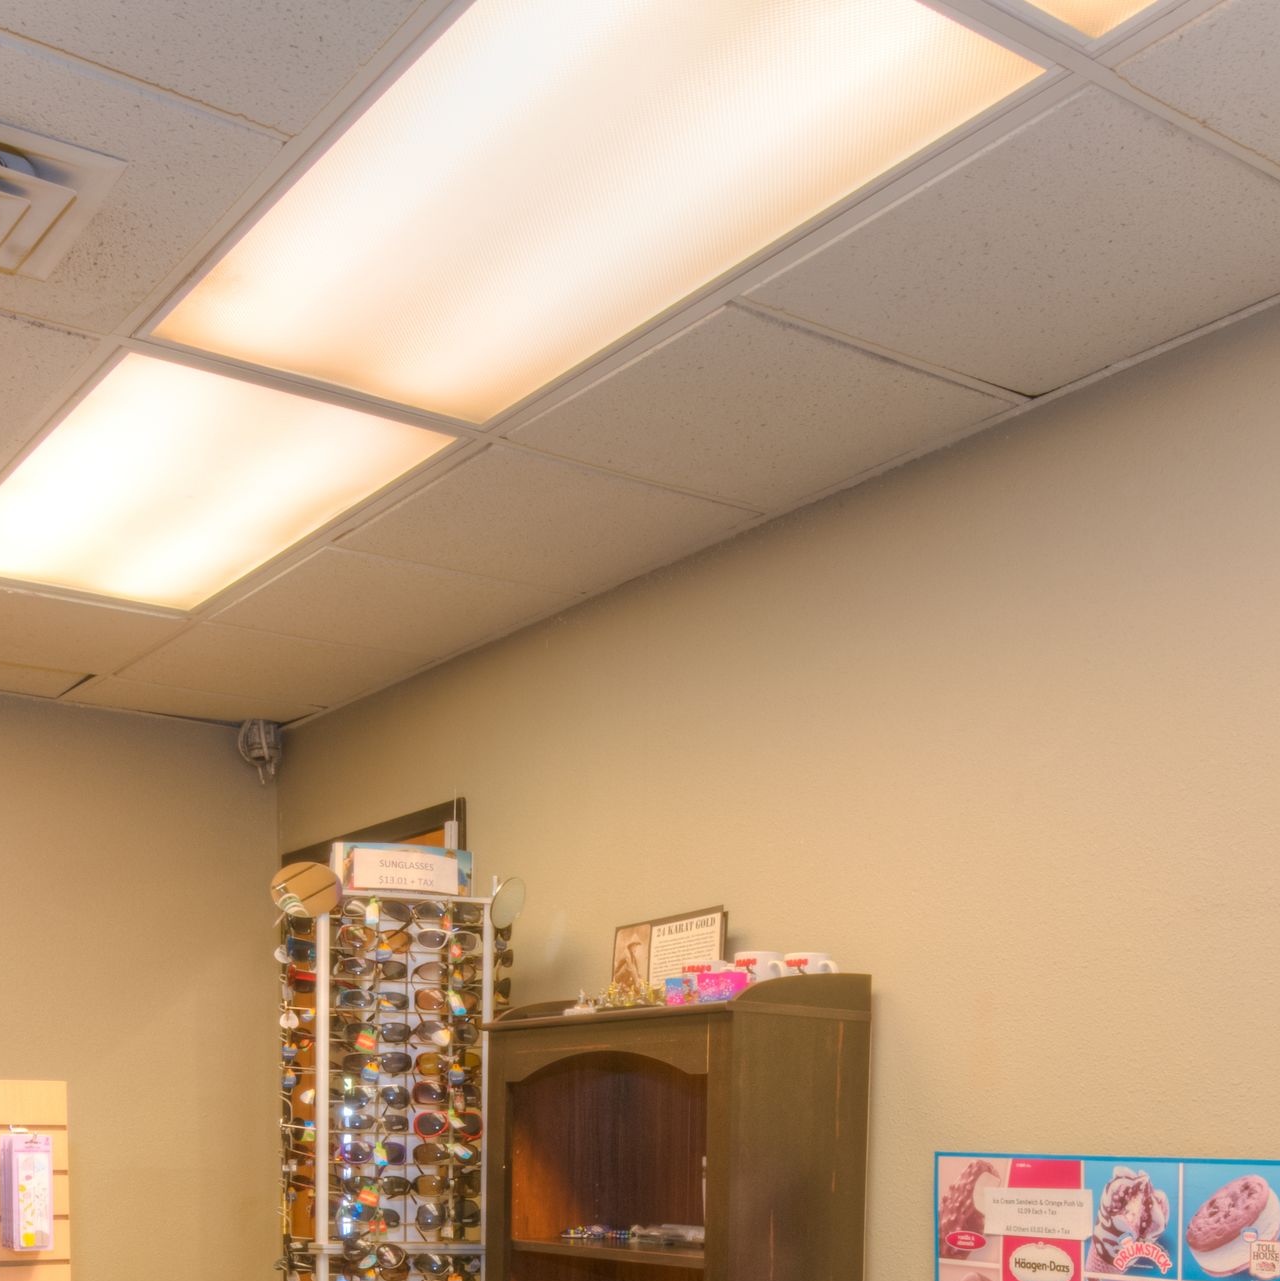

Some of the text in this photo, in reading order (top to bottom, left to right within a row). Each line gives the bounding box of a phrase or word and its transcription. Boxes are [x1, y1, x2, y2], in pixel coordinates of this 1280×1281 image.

[379, 859, 434, 872] SUNGLASSES
[418, 878, 434, 887] TAX
[656, 915, 716, 938] 24 KARAT GOLD
[1256, 1242, 1276, 1252] TOLL
[1113, 1240, 1173, 1275] DRUMSTICK
[1252, 1252, 1280, 1262] HOUSE
